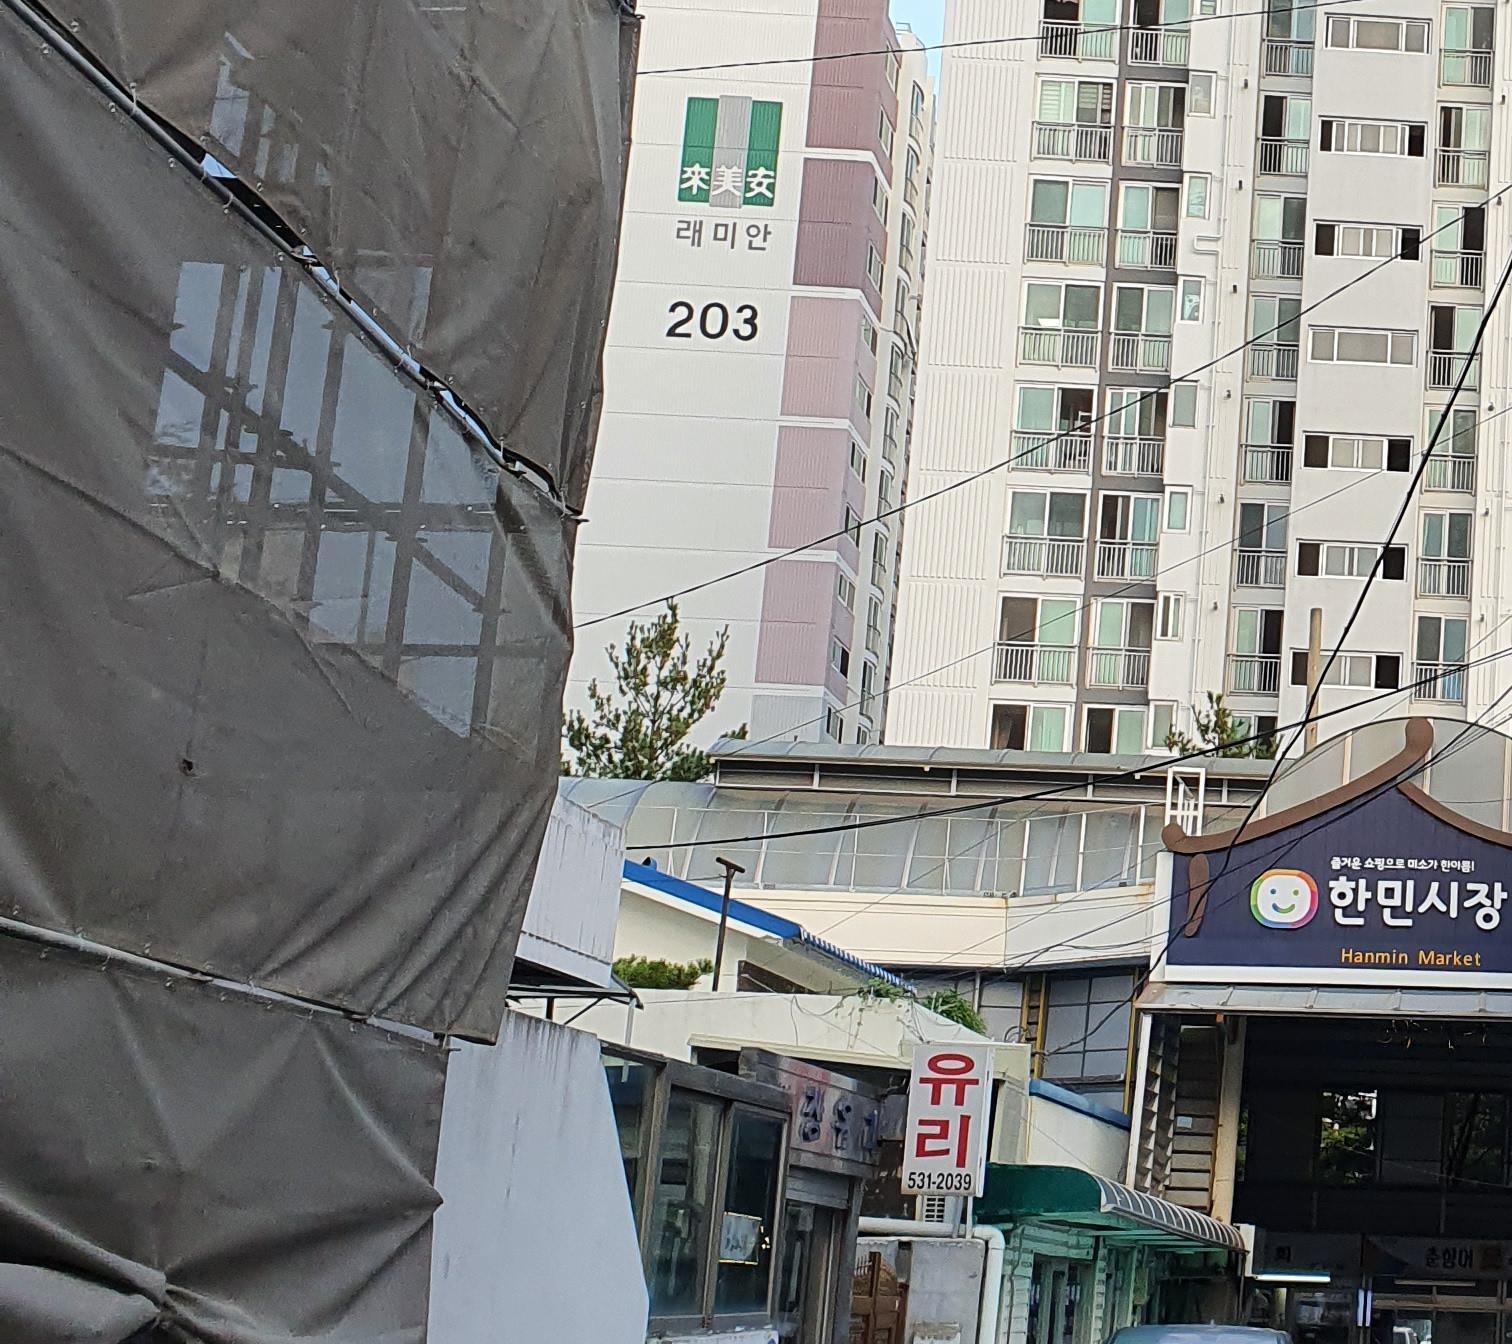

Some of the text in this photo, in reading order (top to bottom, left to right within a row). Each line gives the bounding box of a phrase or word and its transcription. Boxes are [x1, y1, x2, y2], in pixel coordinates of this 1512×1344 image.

[680, 162, 775, 199] 來美安
[676, 219, 772, 252] 래미안
[665, 300, 759, 342] 203
[1331, 857, 1362, 870] 즐거운
[1364, 858, 1405, 871] 쇼핑으로
[1407, 859, 1438, 870] 미소가
[1329, 875, 1508, 931] 한민시장
[1341, 948, 1481, 967] Hanmin Market
[915, 1053, 980, 1169] 유리
[907, 1171, 972, 1191] 531-2039
